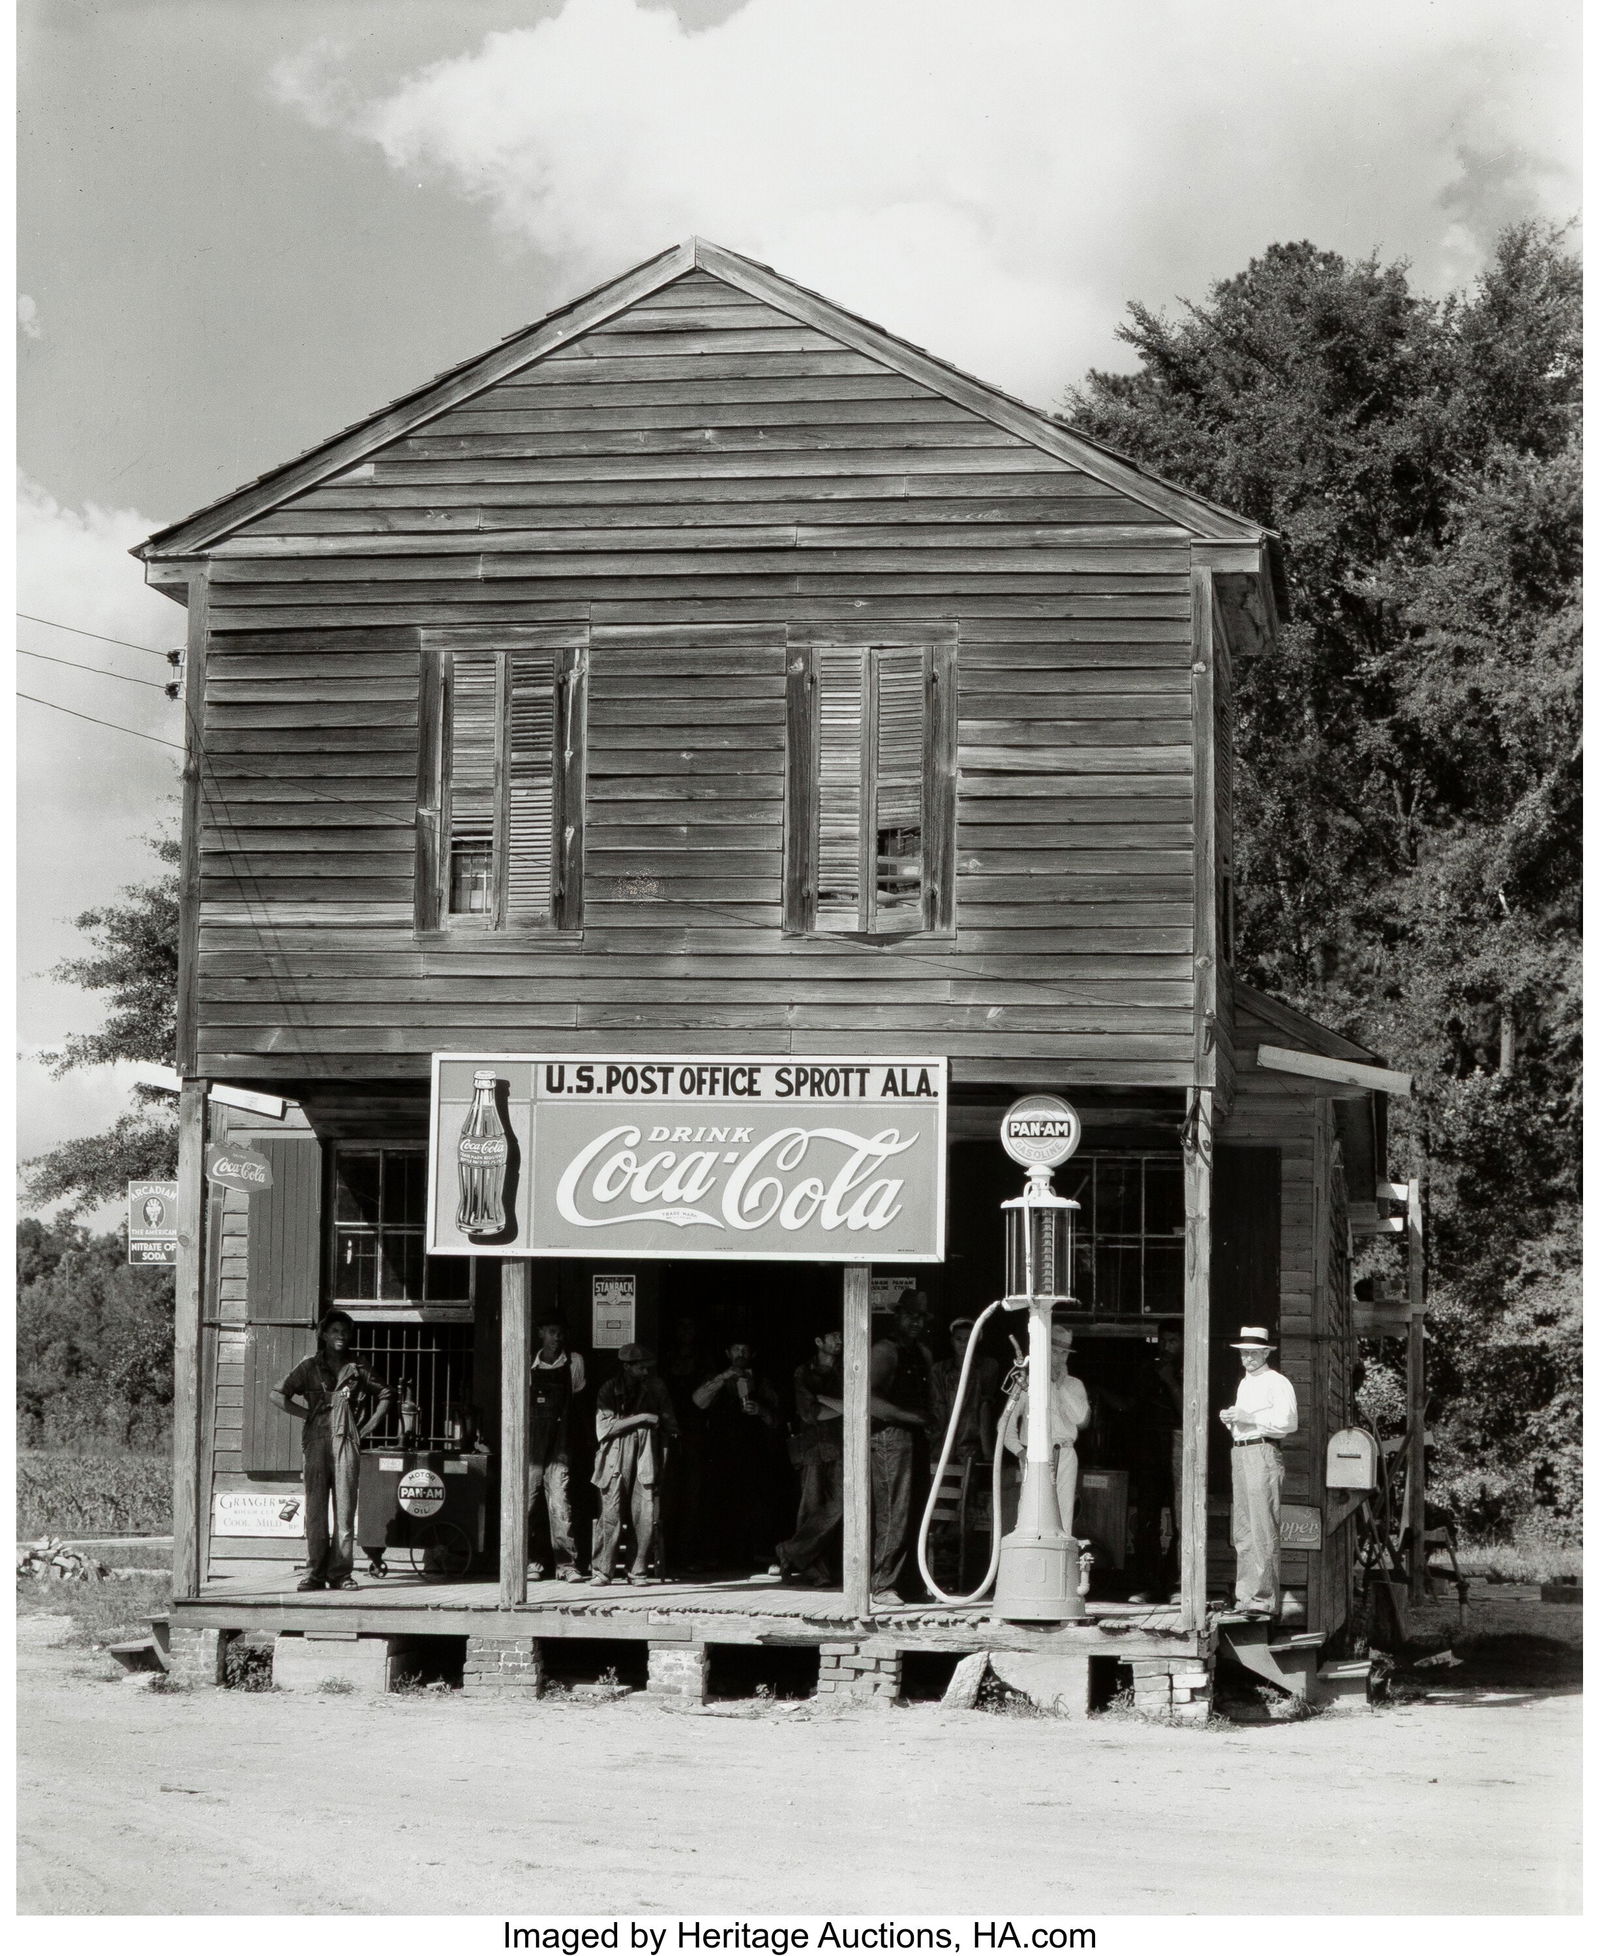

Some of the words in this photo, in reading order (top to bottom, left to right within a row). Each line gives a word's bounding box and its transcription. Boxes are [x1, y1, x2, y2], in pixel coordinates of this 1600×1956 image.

[546, 1065, 603, 1094] U.S.
[606, 1066, 674, 1095] POST
[679, 1067, 761, 1096] OFFICE
[775, 1067, 870, 1097] SPROTT
[881, 1068, 938, 1097] ALA.
[648, 1126, 755, 1143] DRINK
[1010, 1122, 1069, 1136] PAN-AM
[460, 1139, 504, 1154] Coca-Cola
[1015, 1141, 1062, 1158] GASOLINE
[212, 1156, 266, 1183] Coca-Cola
[555, 1125, 920, 1231] Coca-Cola
[131, 1186, 176, 1201] ARCADIAN
[131, 1228, 144, 1236] THE
[145, 1228, 177, 1236] AMERICAN
[131, 1242, 162, 1252] NITRATE
[163, 1242, 177, 1252] OF
[142, 1251, 167, 1261] SODA
[595, 1281, 632, 1292] STANBACK
[409, 1472, 436, 1481] MOTOR
[401, 1487, 442, 1498] PAN-AM
[219, 1493, 276, 1509] GRANGER
[1279, 1521, 1318, 1539] pper
